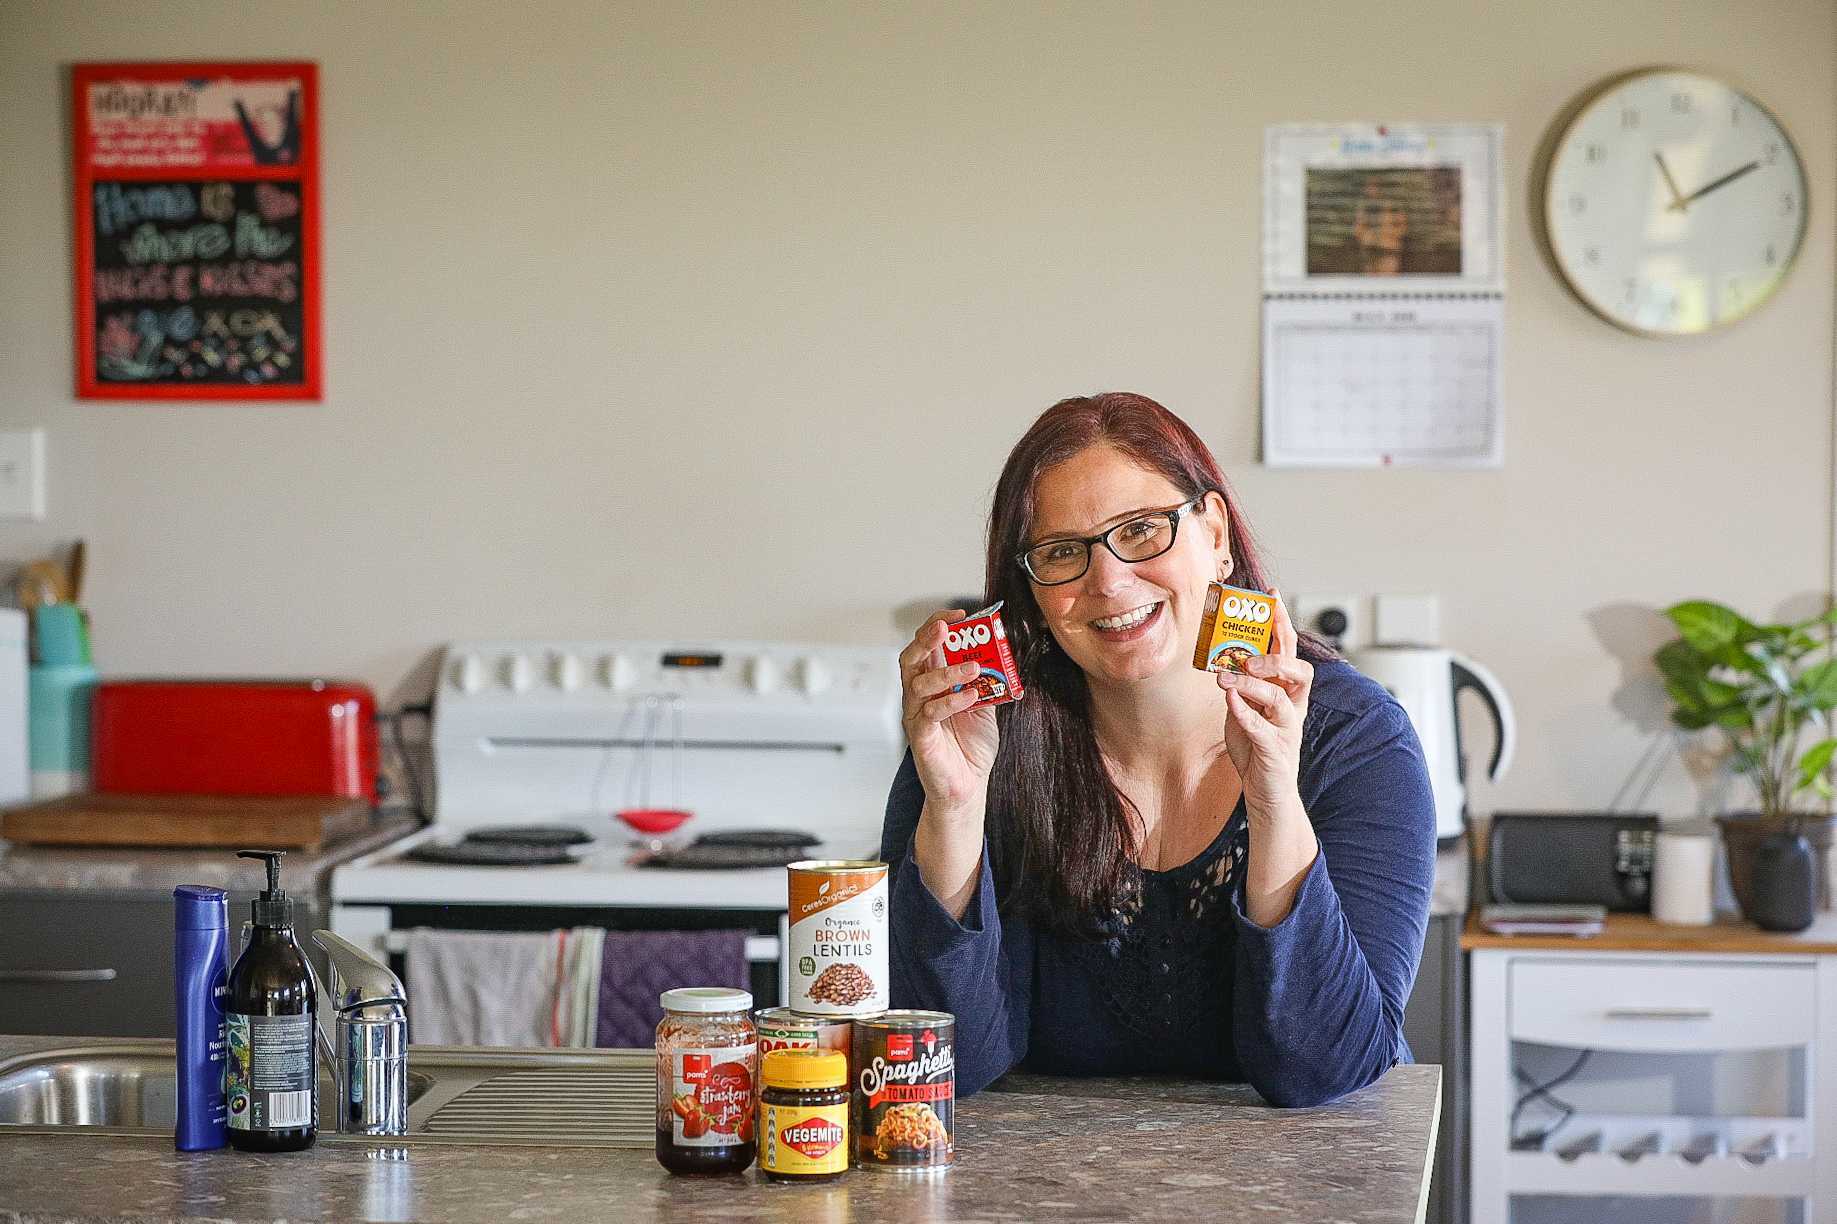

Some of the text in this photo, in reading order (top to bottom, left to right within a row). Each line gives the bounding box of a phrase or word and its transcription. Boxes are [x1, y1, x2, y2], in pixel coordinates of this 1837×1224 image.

[1222, 595, 1271, 624] OXO
[1222, 621, 1265, 636] CHICKEN
[944, 623, 991, 652] OXO
[815, 929, 871, 943] BROWN
[813, 943, 872, 957] LENTILS
[860, 1044, 954, 1096] Spaghetti
[887, 1087, 925, 1100] TOMATO
[716, 1103, 743, 1126] jam
[784, 1127, 842, 1143] VEGEMITE
